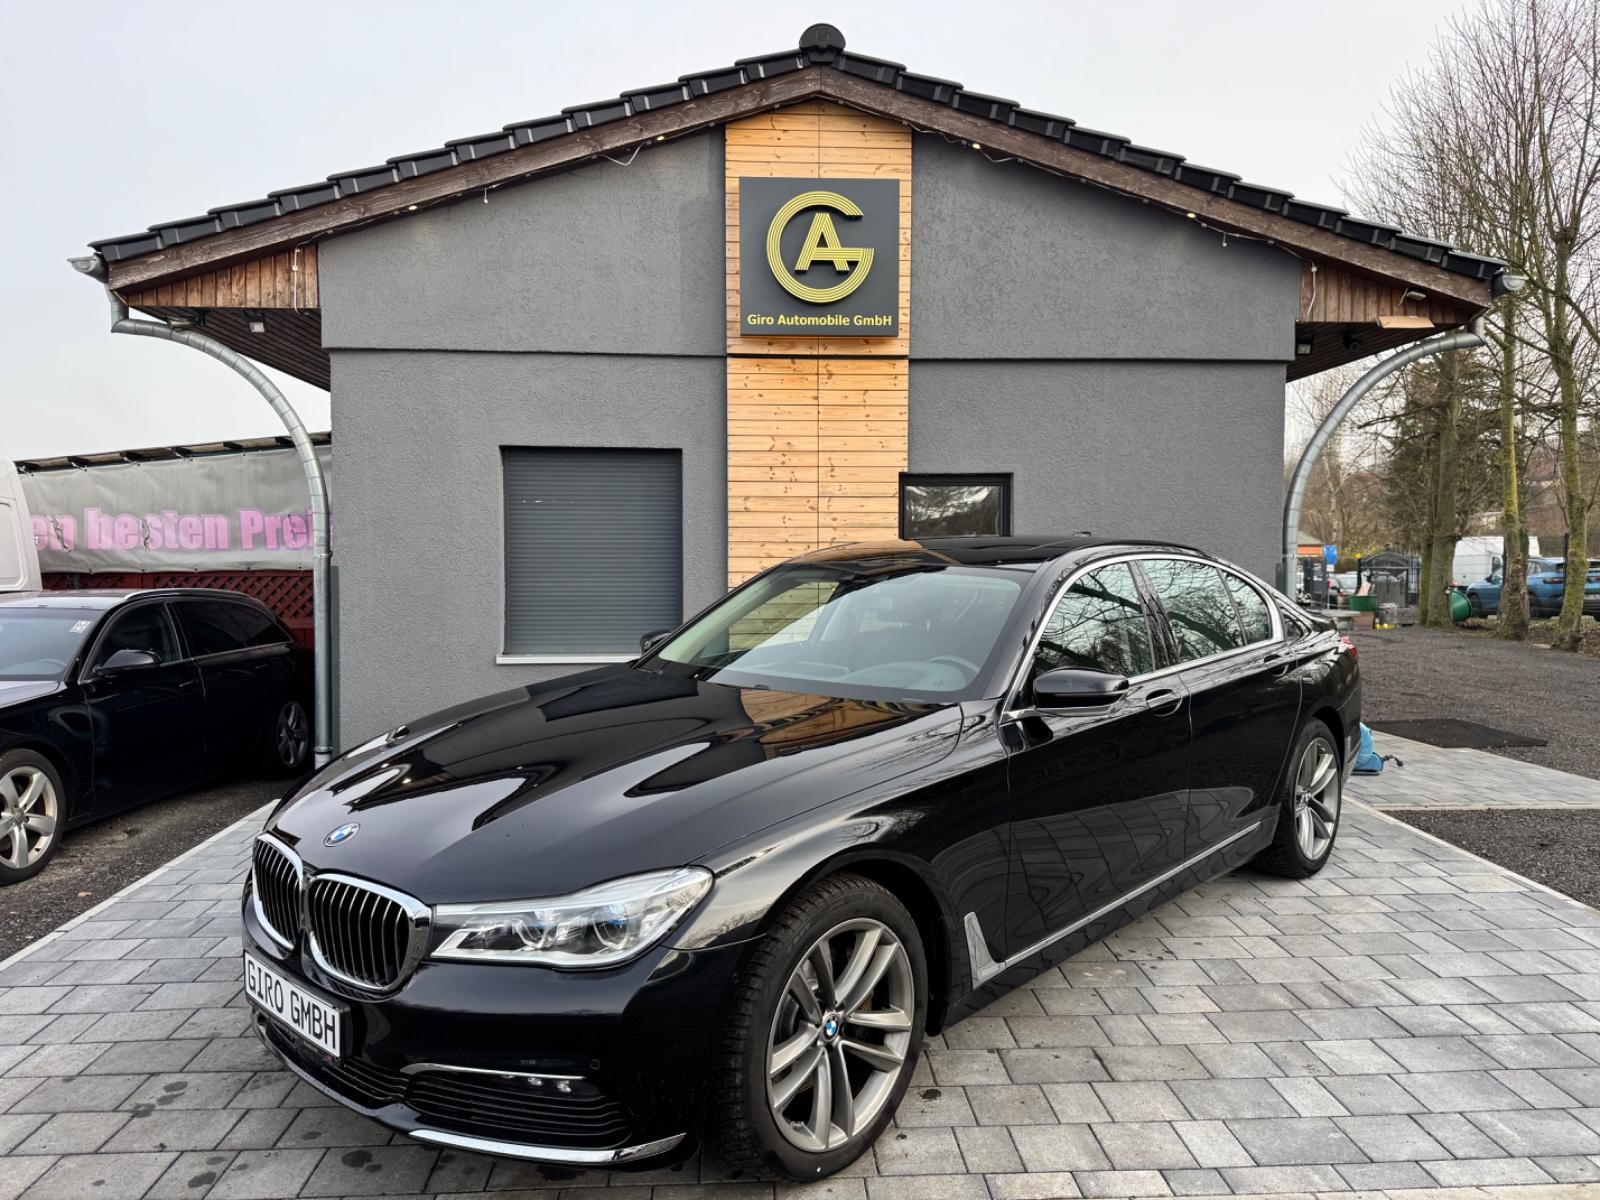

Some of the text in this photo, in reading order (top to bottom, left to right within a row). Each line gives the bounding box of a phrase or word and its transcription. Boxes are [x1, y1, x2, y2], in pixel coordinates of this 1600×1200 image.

[747, 314, 892, 326] Giro Automobile GmbH
[84, 507, 230, 550] besten
[248, 959, 336, 1049] GIRO GMBH
